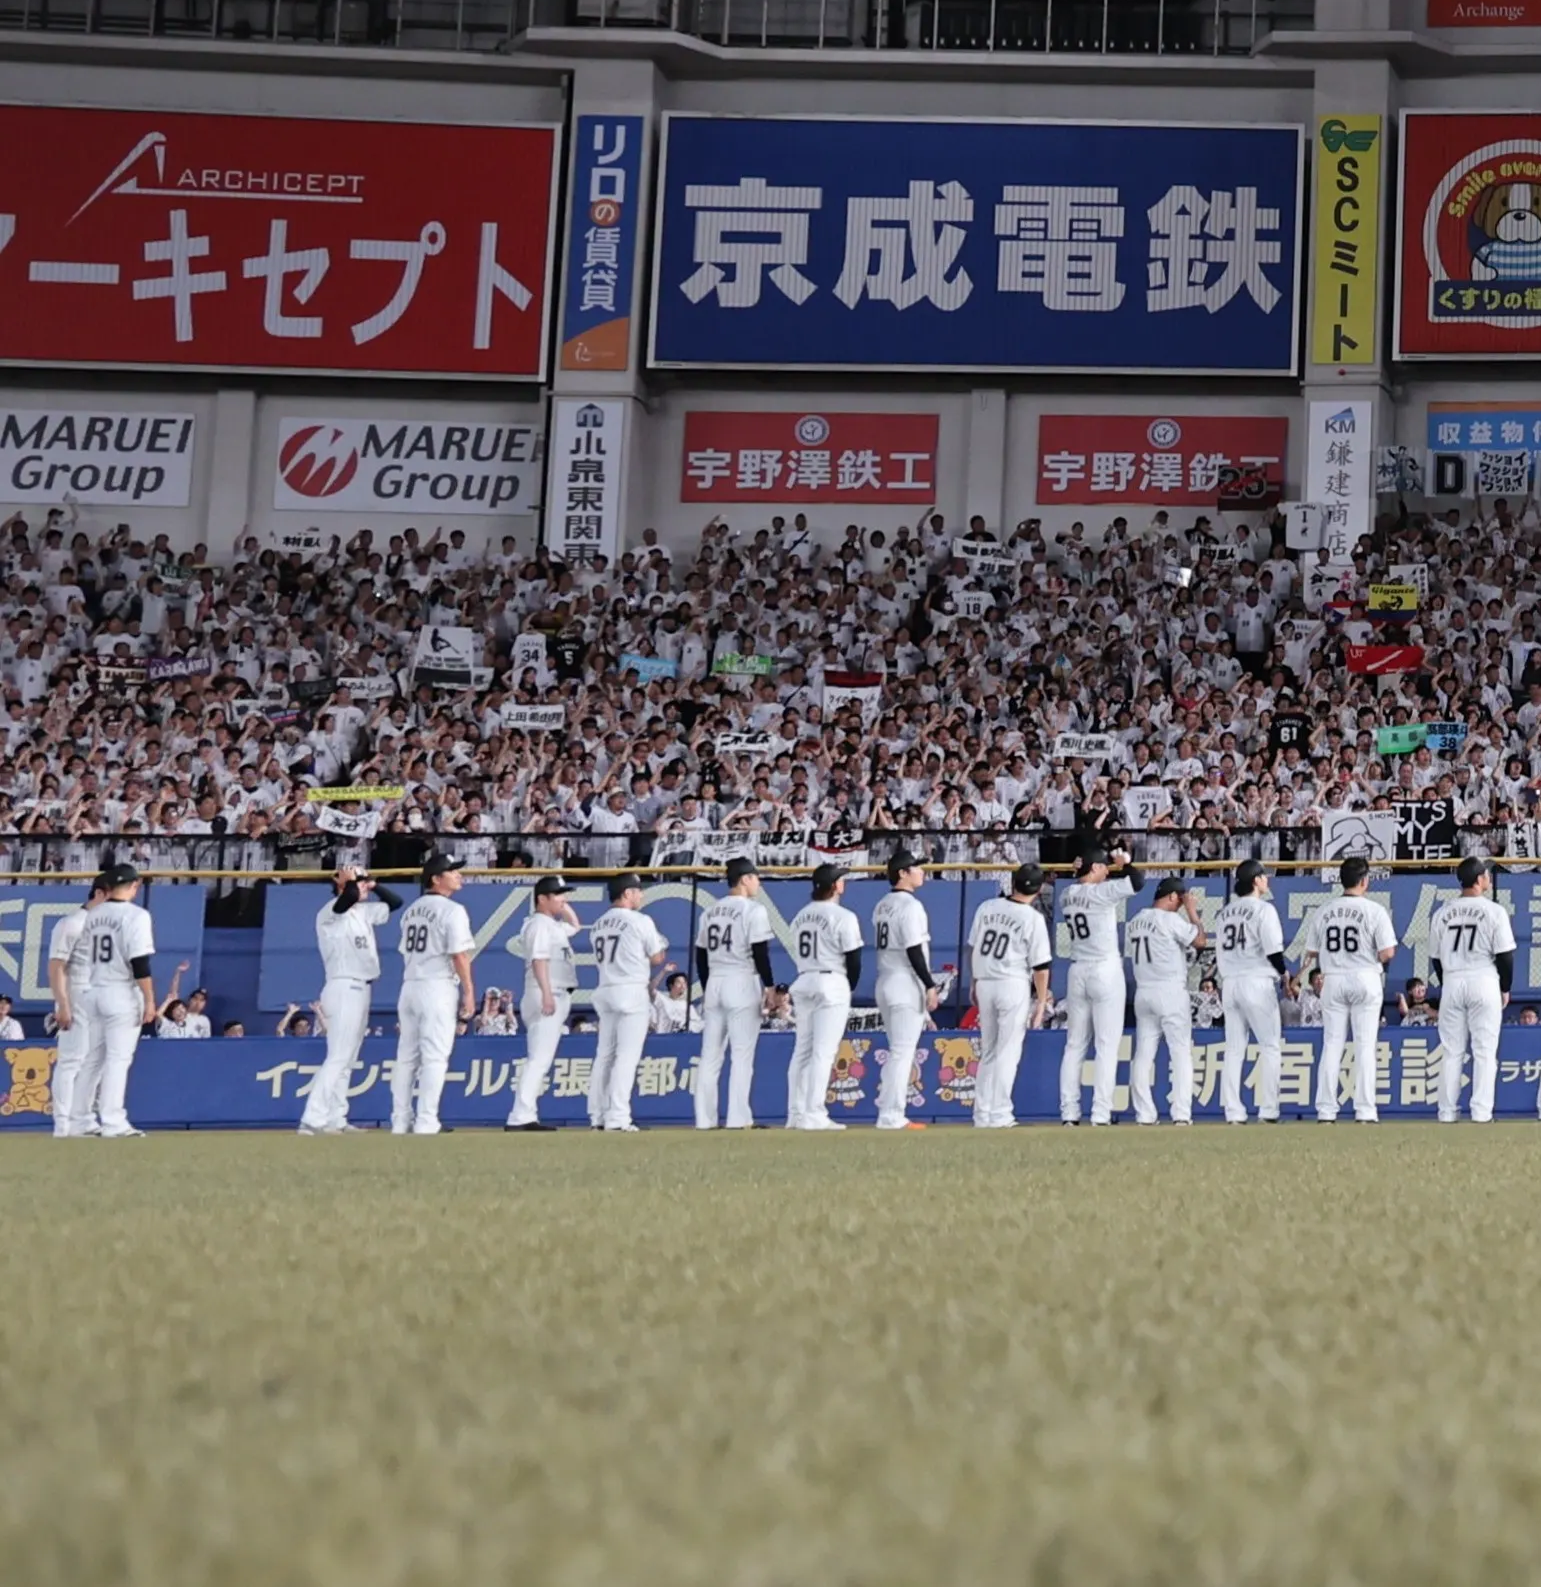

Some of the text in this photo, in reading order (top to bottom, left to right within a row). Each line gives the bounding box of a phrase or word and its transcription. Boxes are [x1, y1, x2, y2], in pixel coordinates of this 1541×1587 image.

[178, 168, 365, 194] ARCHICEPT
[1448, 168, 1496, 218] Smile
[580, 125, 627, 312] リロの賃貸
[679, 177, 1283, 314] 京成電鉄
[1331, 156, 1362, 361] SCミート
[0, 209, 534, 350] ーキセプト
[0, 416, 193, 454] MARUEI
[1324, 418, 1356, 434] KM
[10, 456, 166, 500] Group
[687, 447, 932, 491] 宇野澤鉄工
[372, 464, 521, 509] Group
[1324, 439, 1354, 558] 鎌建商店
[1138, 801, 1158, 819] 21
[1393, 819, 1436, 845] MY
[1323, 907, 1365, 924] SABURO
[91, 934, 113, 963] 19
[406, 925, 429, 953] 88
[594, 935, 620, 964] 87
[707, 924, 733, 952] 64
[799, 930, 819, 960] 61
[980, 929, 1010, 960] 80
[1130, 936, 1153, 964] 71
[1222, 924, 1247, 951] 34
[1325, 925, 1359, 954] 86
[1447, 924, 1478, 952] 77
